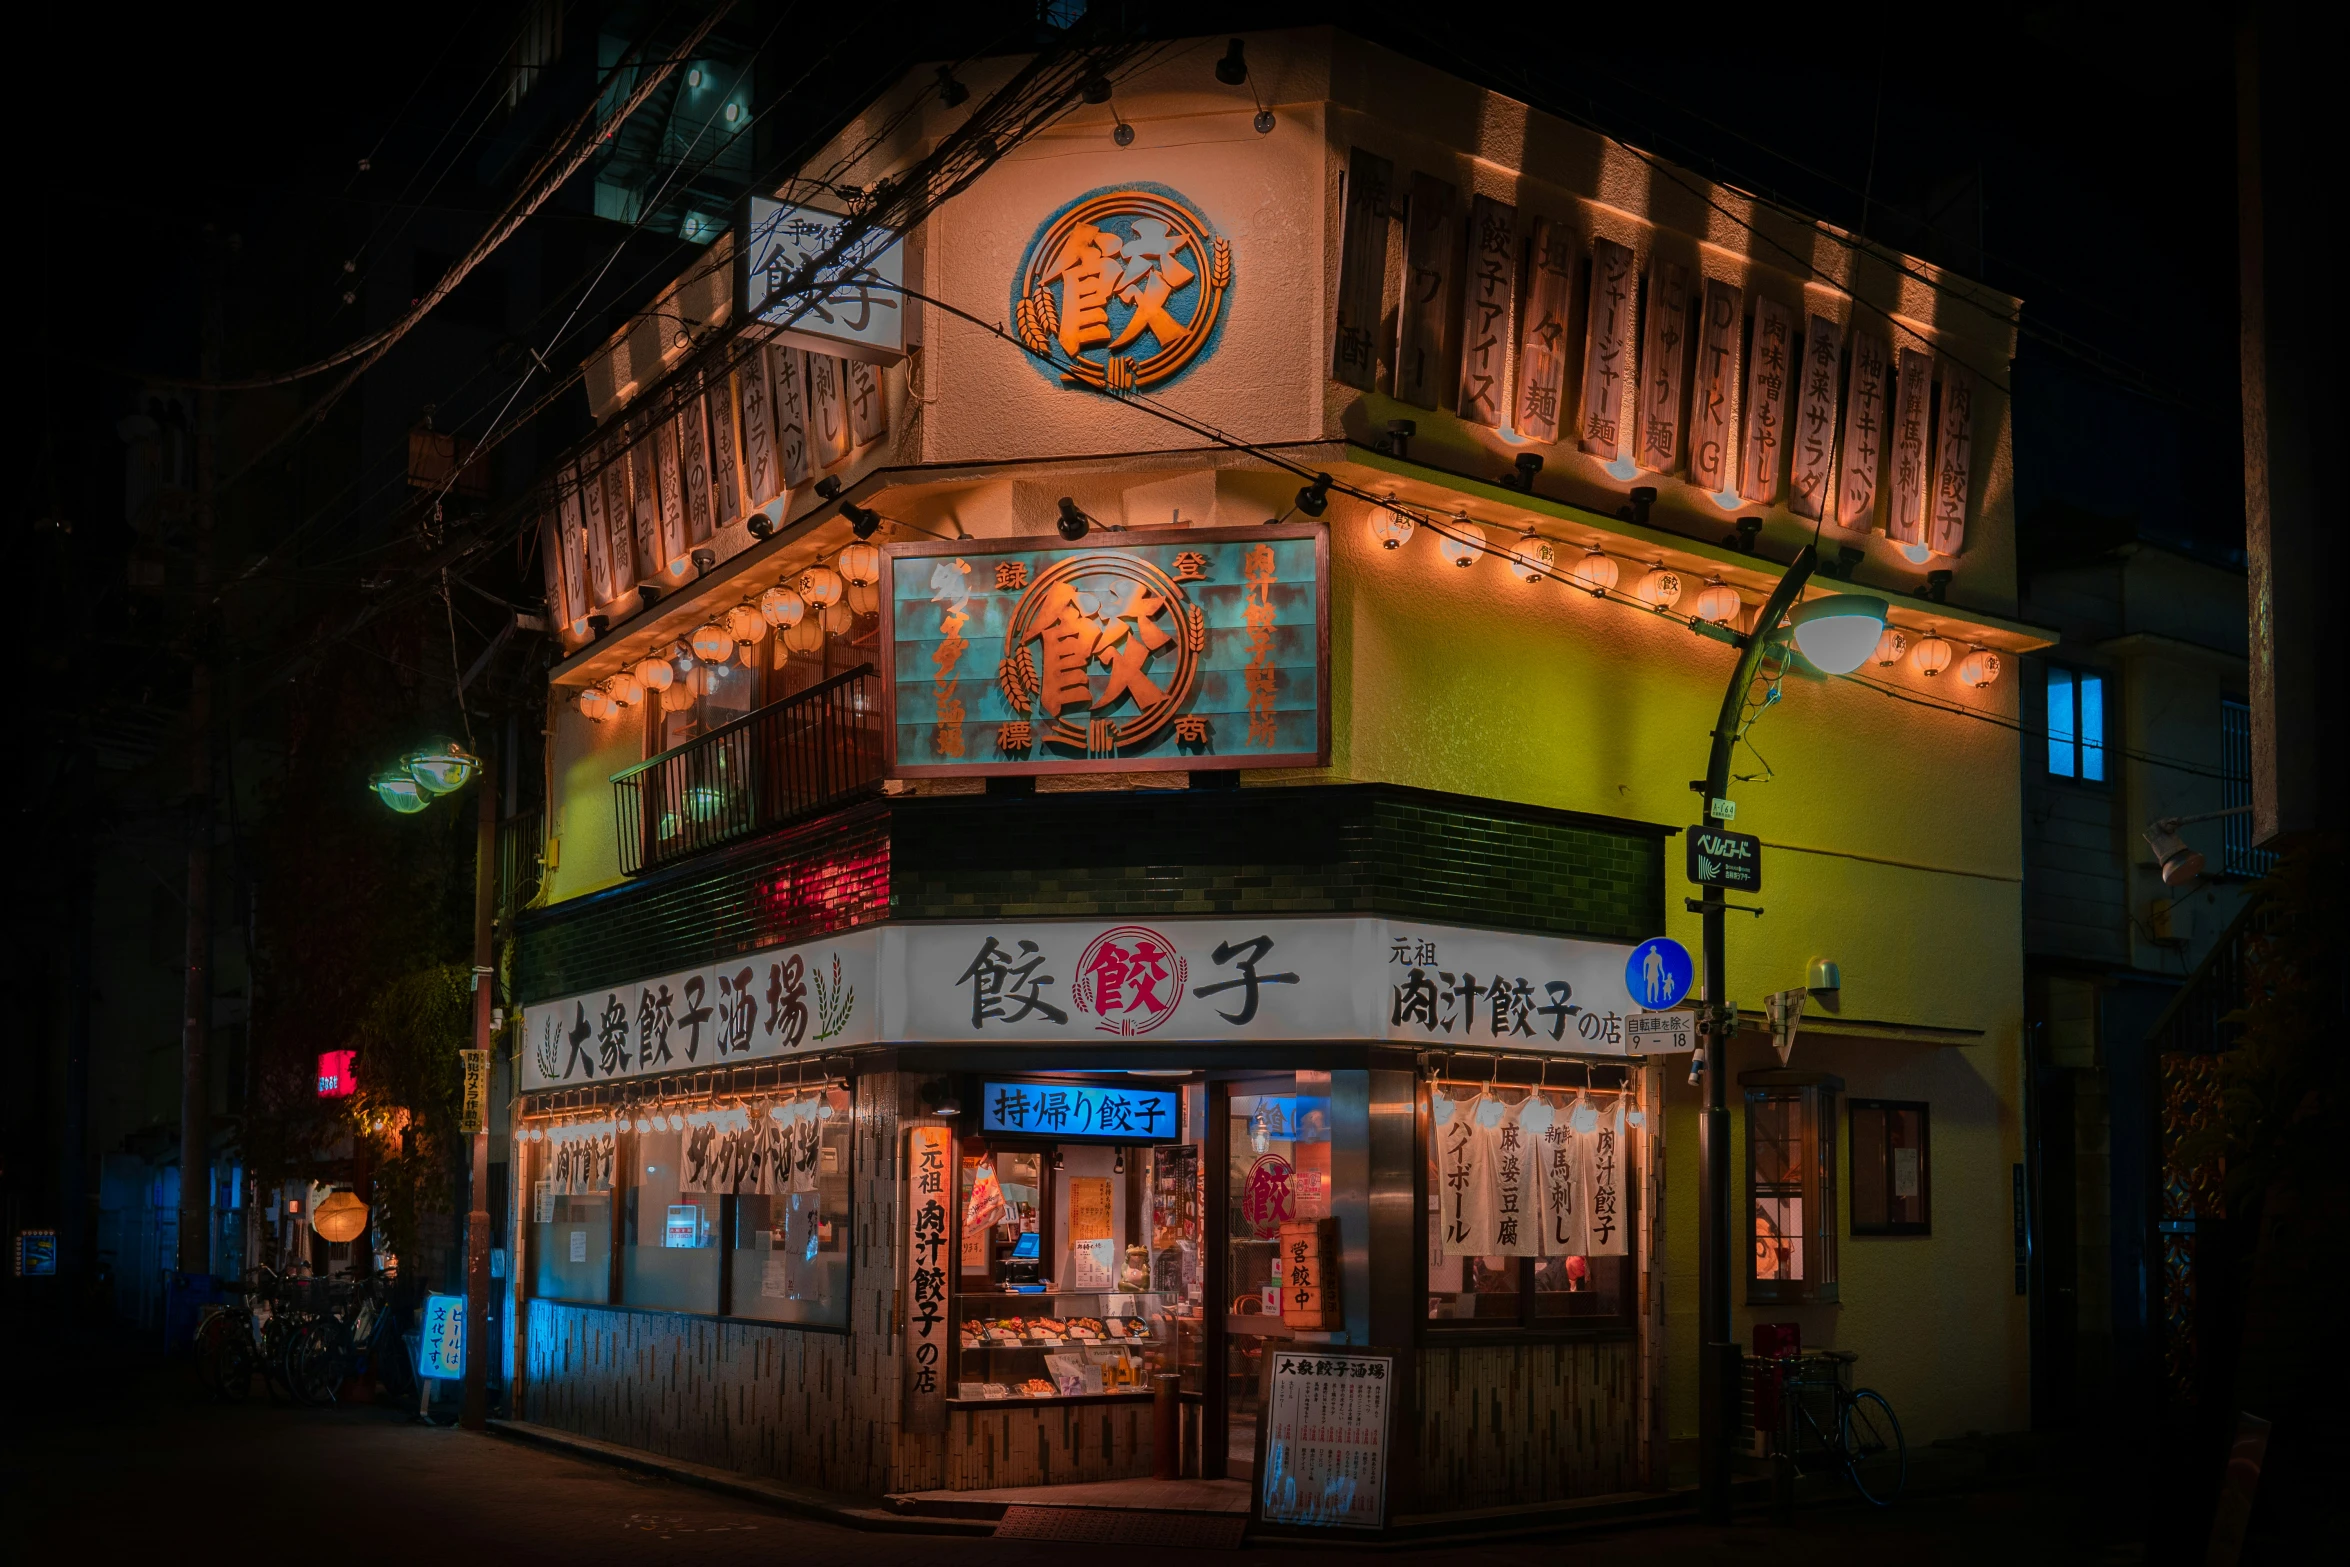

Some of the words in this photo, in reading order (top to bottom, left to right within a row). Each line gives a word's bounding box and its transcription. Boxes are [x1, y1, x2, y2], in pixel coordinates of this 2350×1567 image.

[1038, 217, 1196, 357] 餃
[1468, 213, 1510, 411] 餃子アイス
[1588, 253, 1633, 447] ジャージャー麺
[1645, 275, 1683, 460] にゅう麺
[1699, 295, 1734, 477] DTKG
[745, 352, 770, 491] 菜サラダ
[1753, 313, 1787, 485] 肉味噌もやし
[1800, 332, 1837, 499] 香菜サラダ
[1848, 348, 1884, 515] 柚子キャベツ
[659, 425, 680, 540] 羽餃子
[1896, 365, 1925, 530] 新鮮馬刺し
[1935, 379, 1972, 542] 肉汁餃子
[995, 560, 1029, 590] 録
[1172, 551, 1208, 581] 登
[1661, 575, 1679, 592] 餃
[1020, 578, 1178, 718] 餃
[997, 721, 1033, 750] 標
[1173, 714, 1209, 750] 商
[1388, 937, 1439, 967] 元祖
[563, 953, 808, 1080] 大衆餃子酒場
[1391, 966, 1623, 1045] 肉汁餃子の店
[1628, 1016, 1691, 1033] 自転車を除く
[1632, 1035, 1641, 1050] 9
[1673, 1033, 1687, 1048] 18
[464, 1052, 480, 1129] 防犯カメラ作動中
[992, 1087, 1167, 1135] 持帰り餃子
[1544, 1124, 1573, 1144] 新鮮
[918, 1142, 944, 1195] 元祖
[1249, 1165, 1290, 1225] 餃
[1446, 1121, 1473, 1244] ハイボール
[1496, 1124, 1521, 1247] 麻婆豆腐
[1550, 1149, 1572, 1245] 馬刺し
[1593, 1127, 1617, 1245] 肉汁餃子
[911, 1200, 948, 1394] 肉汁餃子の店
[1290, 1240, 1312, 1311] 営餃中
[428, 1307, 446, 1370] 文化です。
[447, 1309, 461, 1364] ビールは
[1279, 1358, 1385, 1380] 大衆餃子酒場
